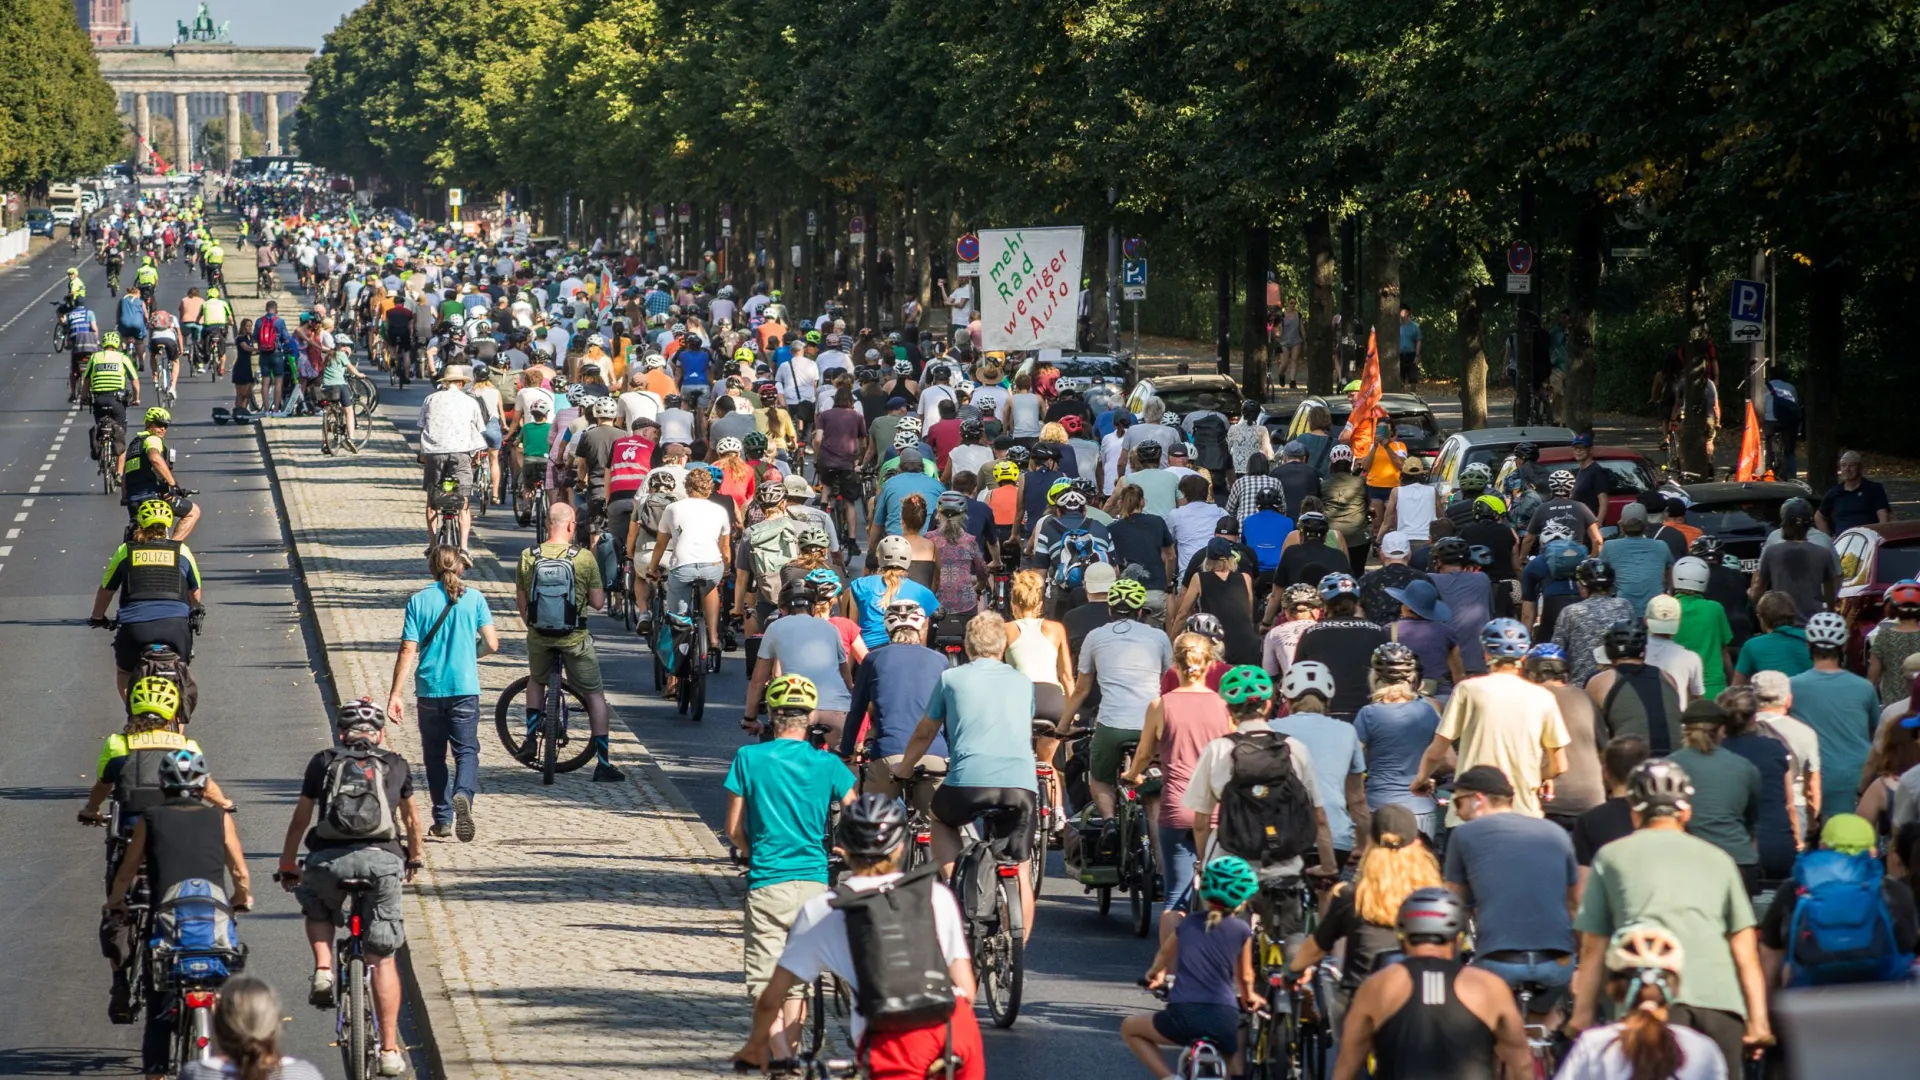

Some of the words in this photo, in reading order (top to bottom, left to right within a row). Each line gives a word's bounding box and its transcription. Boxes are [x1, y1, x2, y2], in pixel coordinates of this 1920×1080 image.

[989, 231, 1024, 283] mehr
[1127, 262, 1140, 283] P
[997, 251, 1034, 305] Rad
[1004, 249, 1067, 335] weniger
[1029, 281, 1069, 340] Auto
[1738, 285, 1758, 316] P
[135, 552, 172, 563] POLIZEI
[132, 732, 184, 745] POLIZEI
